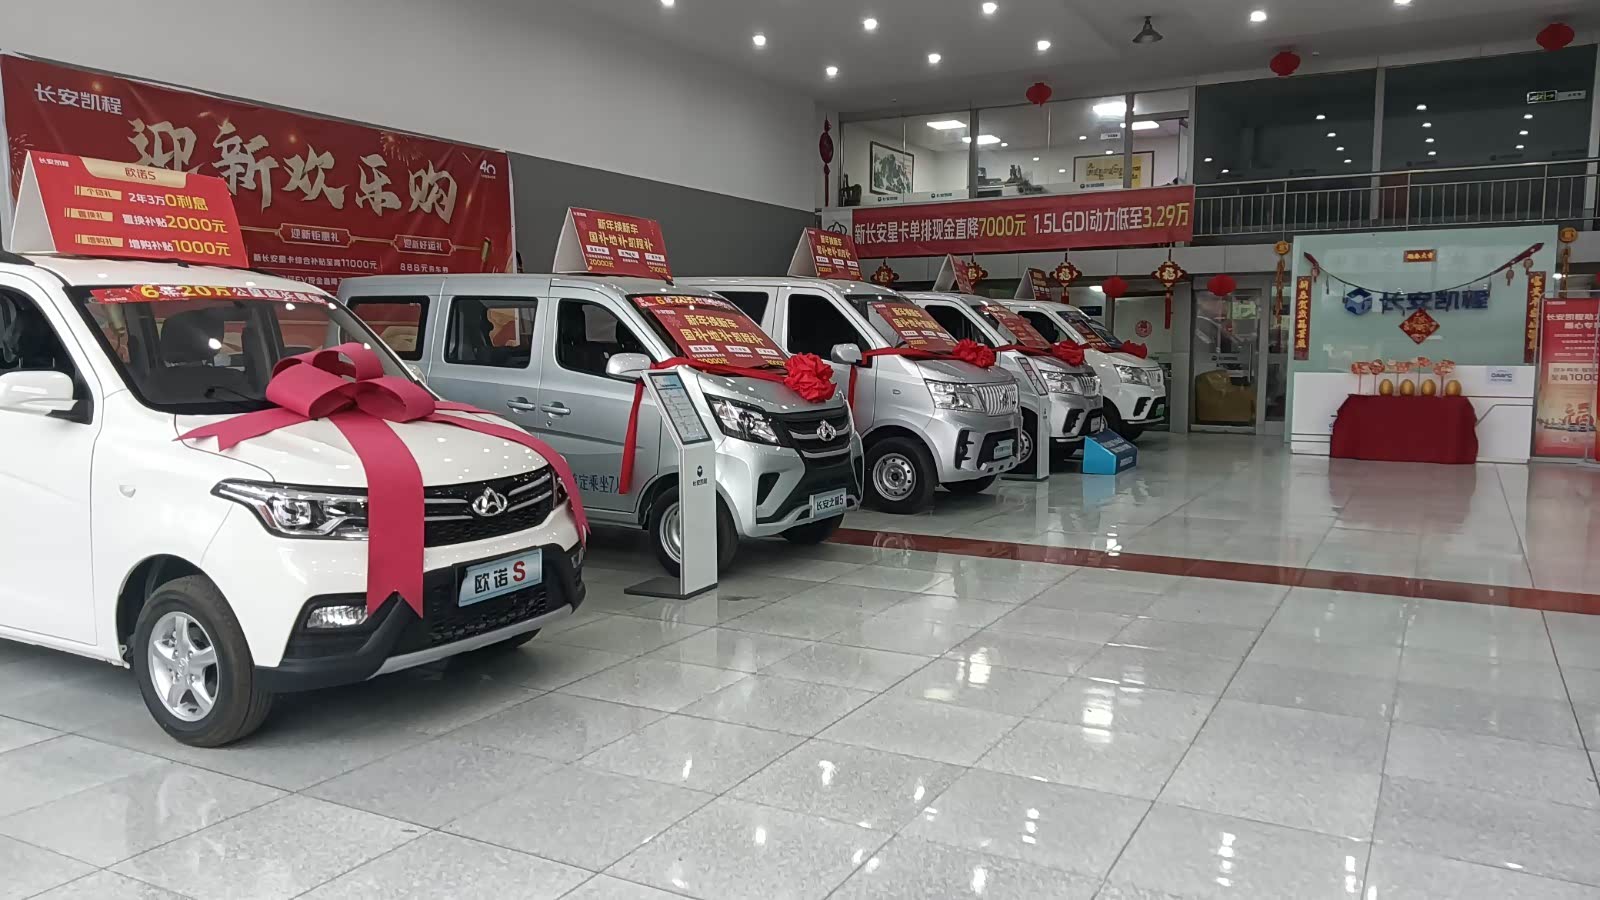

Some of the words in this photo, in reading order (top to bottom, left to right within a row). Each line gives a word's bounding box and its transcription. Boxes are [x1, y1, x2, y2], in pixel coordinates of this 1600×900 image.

[34, 83, 122, 115] 长安凯程
[124, 167, 156, 181] 欧诺S
[127, 117, 457, 224] 迎新欢乐购
[128, 192, 208, 211] 2年3万0利息
[122, 213, 228, 234] 置换补贴2000元
[597, 218, 639, 234] 新年换新车
[854, 213, 1027, 245] 新长安星卡单排现金直降7000元
[1033, 202, 1190, 234] 1.5LGDI动力低至3.29万
[128, 238, 231, 257] 增购补贴1000元
[1379, 290, 1489, 313] 长安凯程
[573, 473, 620, 494] 定乘坐7
[474, 560, 527, 595] 欧诺S
